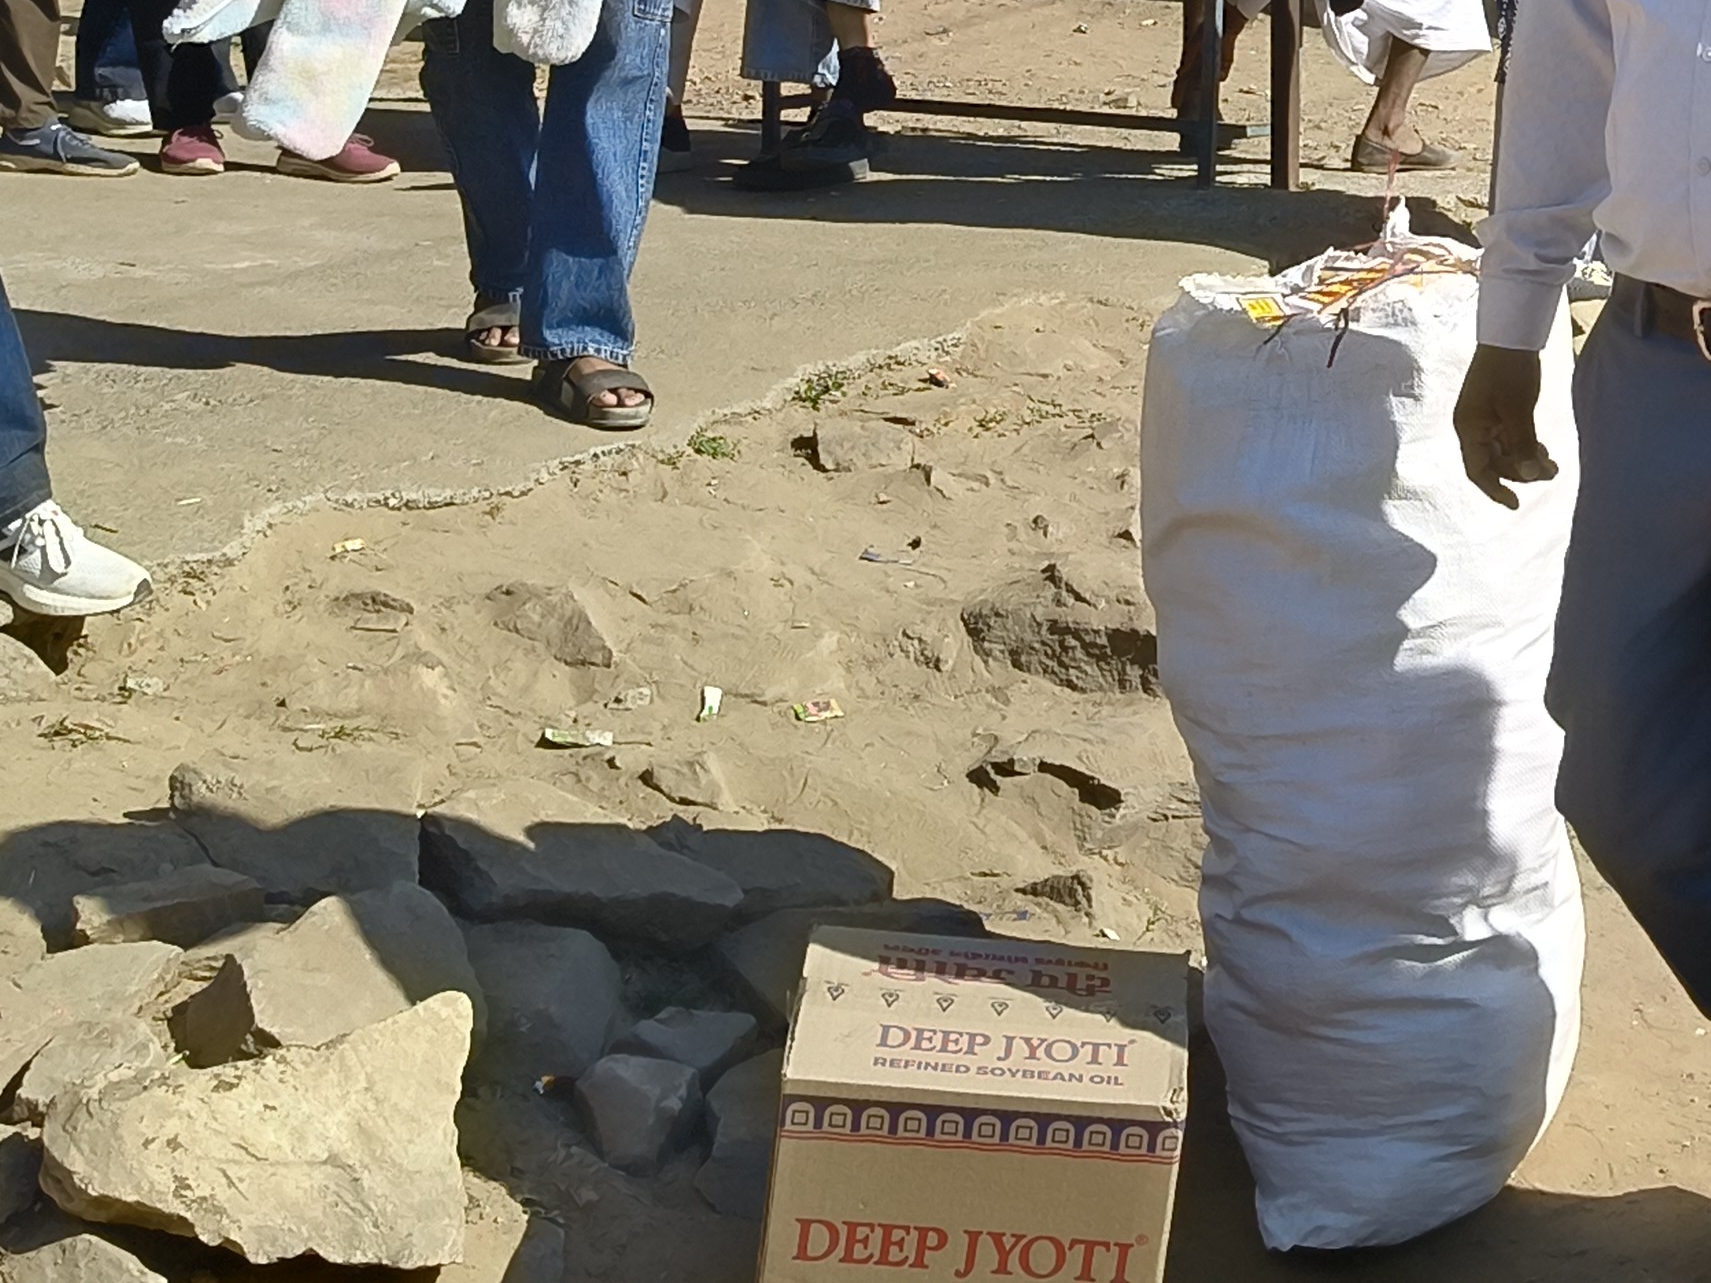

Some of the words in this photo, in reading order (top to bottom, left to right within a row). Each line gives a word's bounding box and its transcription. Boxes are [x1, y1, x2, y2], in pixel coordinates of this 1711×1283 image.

[1025, 968, 1112, 998] दीप
[875, 1022, 993, 1062] DEEP
[997, 1034, 1131, 1068] JYOTI
[872, 1055, 972, 1077] REFINED
[975, 1064, 1084, 1086] SOYBEAN
[1089, 1073, 1124, 1087] OIL
[792, 1217, 949, 1270] DEEP
[955, 1228, 1137, 1283] JYOTI
